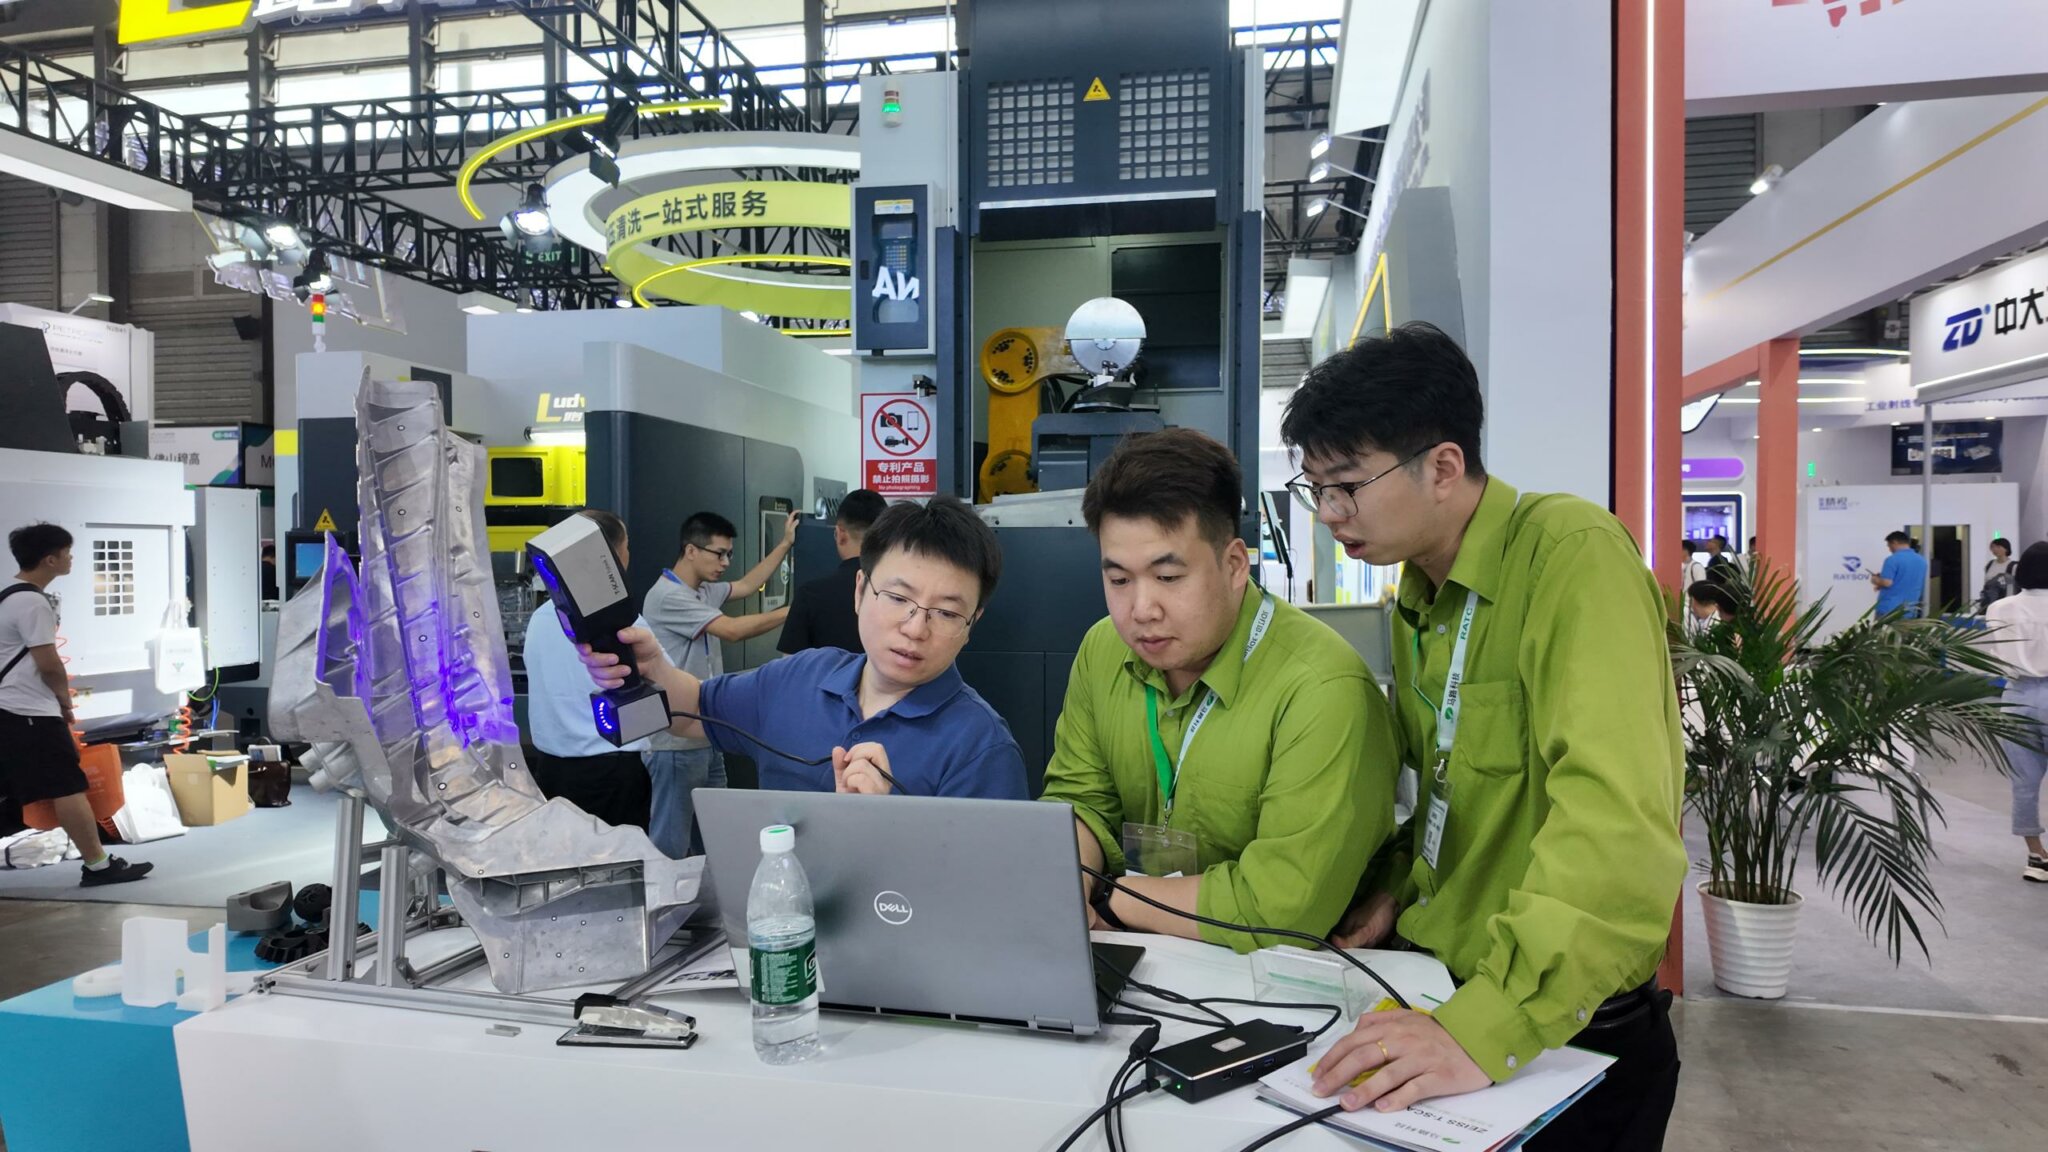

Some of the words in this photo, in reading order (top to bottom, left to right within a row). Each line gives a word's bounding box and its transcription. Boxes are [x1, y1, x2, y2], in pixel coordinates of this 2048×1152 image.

[877, 461, 925, 473] 专利产品
[879, 902, 909, 913] DELL
[1446, 1119, 1489, 1134] ZEISS
